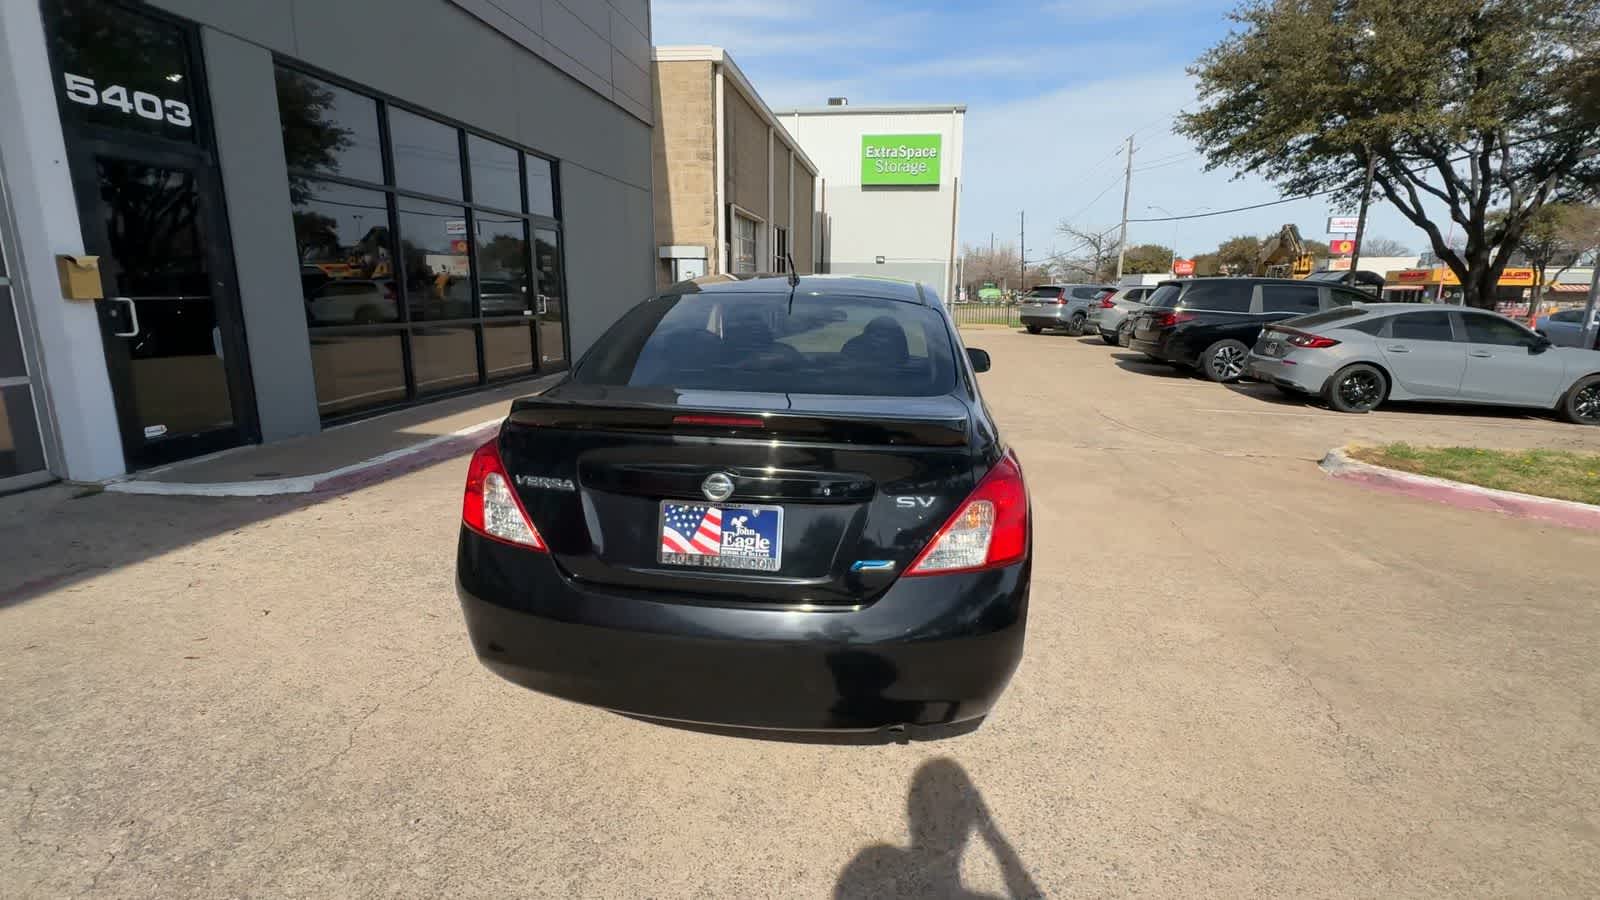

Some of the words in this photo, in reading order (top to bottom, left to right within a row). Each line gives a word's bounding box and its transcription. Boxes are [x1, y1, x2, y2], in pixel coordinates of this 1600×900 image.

[64, 72, 192, 127] 5403
[875, 159, 926, 175] Storage
[515, 474, 575, 491] VERSA
[896, 495, 936, 508] SV
[736, 526, 755, 536] John
[722, 531, 770, 552] Eagle
[661, 552, 700, 566] EAGLE
